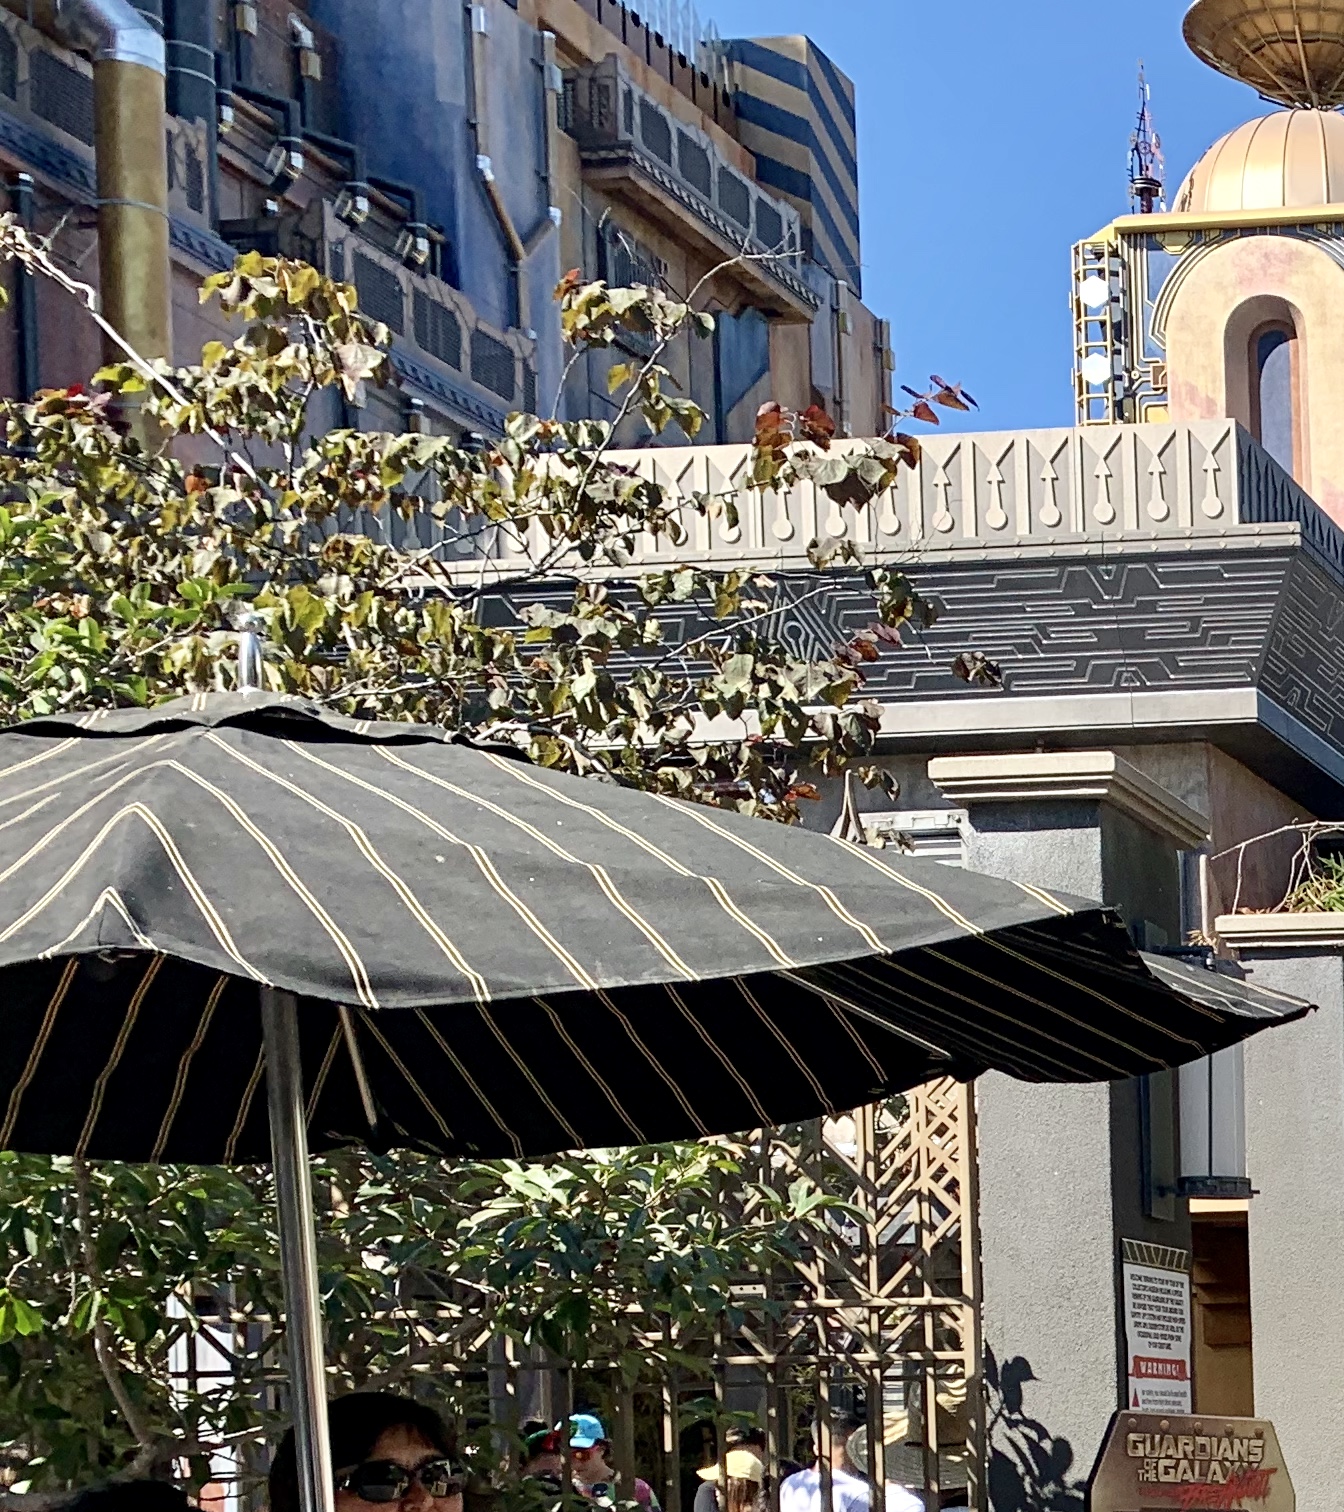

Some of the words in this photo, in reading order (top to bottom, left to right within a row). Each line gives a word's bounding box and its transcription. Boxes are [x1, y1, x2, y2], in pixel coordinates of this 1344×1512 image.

[1127, 1433, 1264, 1462] GUARDIANS
[1144, 1458, 1158, 1470] OF
[1138, 1469, 1158, 1482] THE
